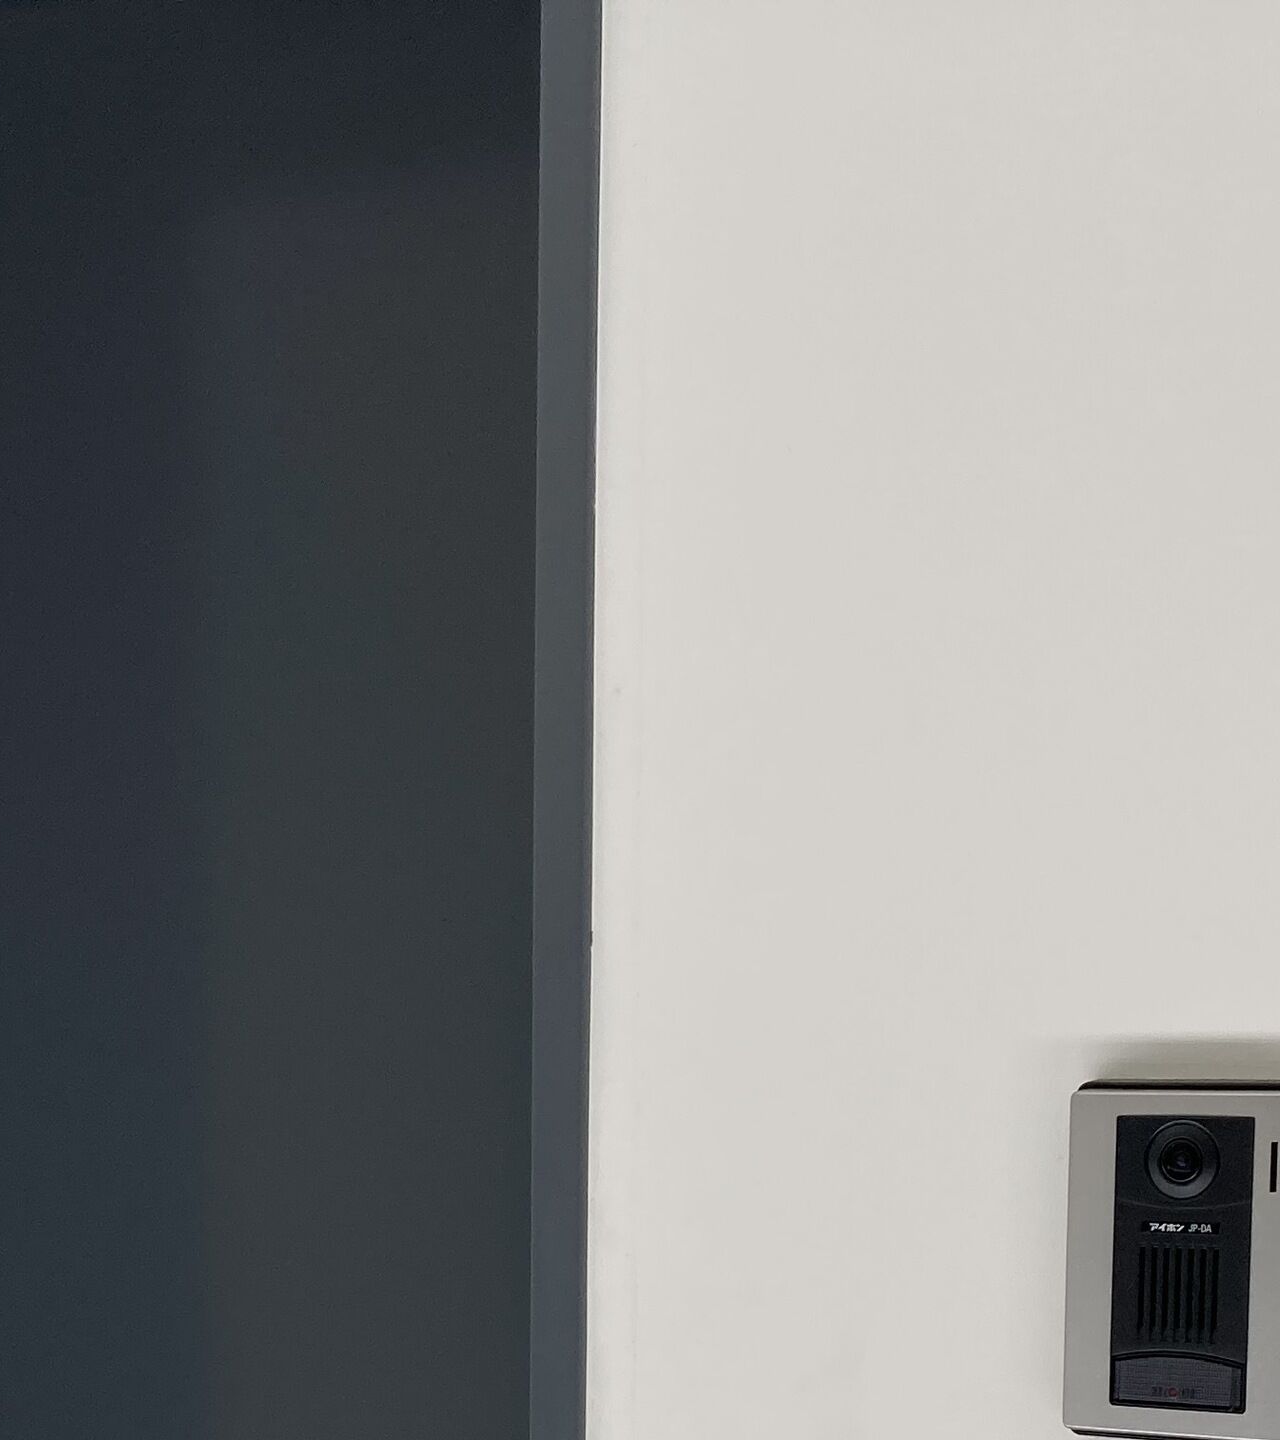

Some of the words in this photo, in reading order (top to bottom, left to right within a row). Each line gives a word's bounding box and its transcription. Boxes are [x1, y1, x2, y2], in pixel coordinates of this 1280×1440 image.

[1148, 1222, 1185, 1233] アイホン
[1188, 1223, 1212, 1233] JP-DA
